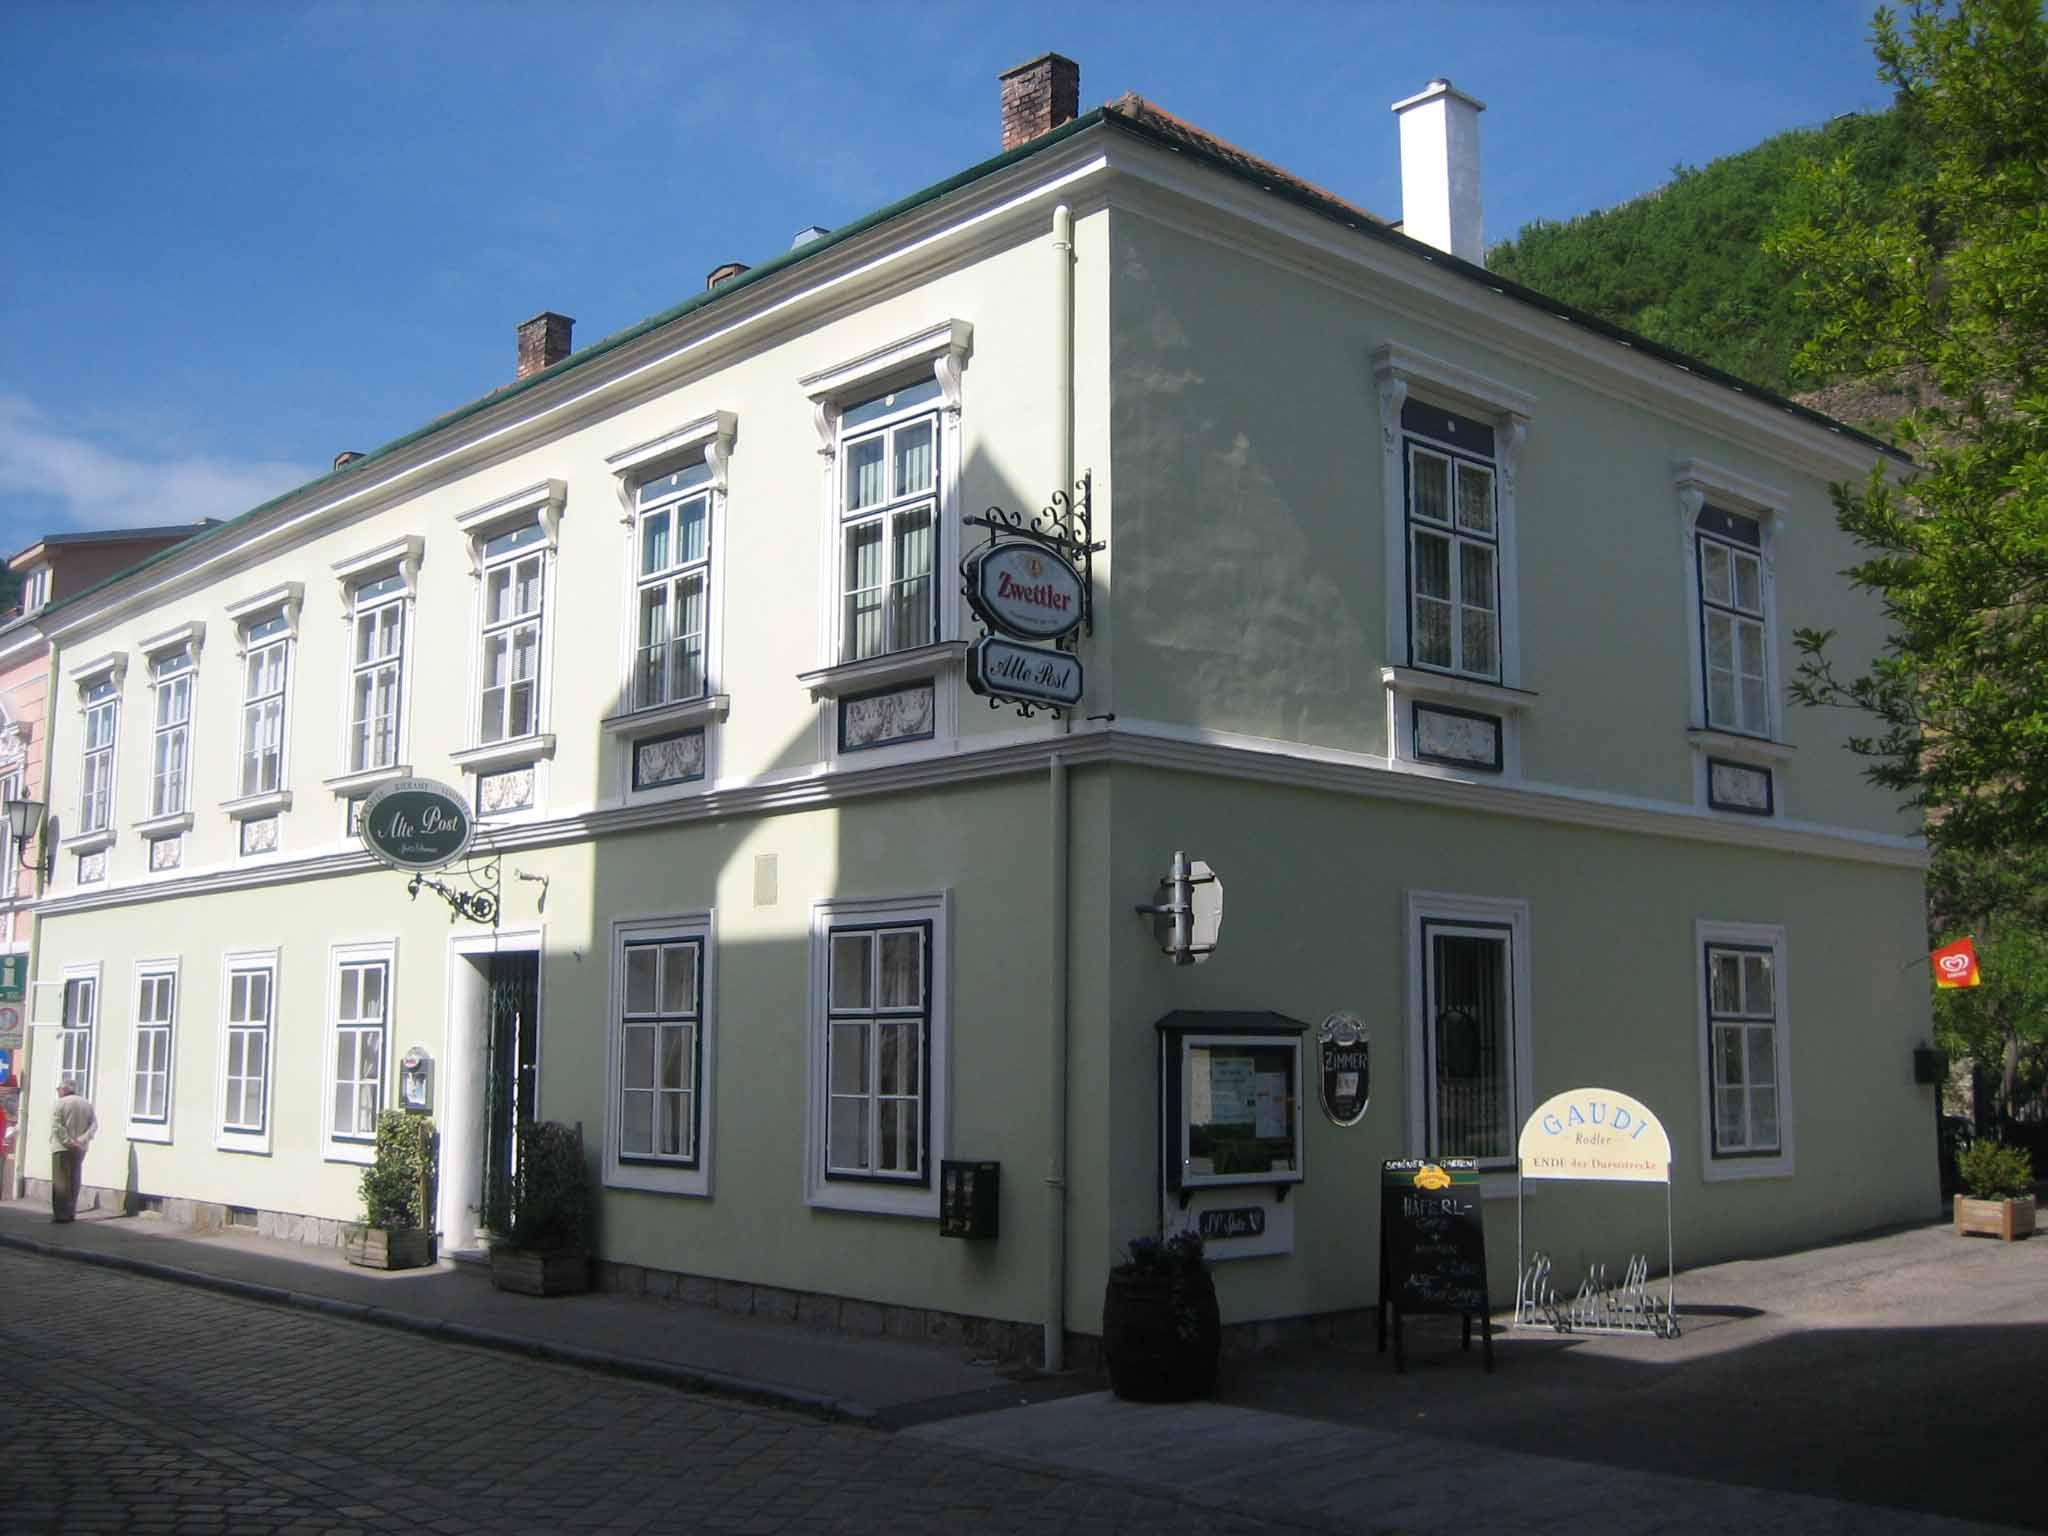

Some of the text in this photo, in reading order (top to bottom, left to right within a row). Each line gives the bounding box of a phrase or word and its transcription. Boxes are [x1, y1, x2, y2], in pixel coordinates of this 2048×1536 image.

[998, 571, 1071, 611] Zwettler
[990, 655, 1071, 689] Alte Post
[378, 806, 458, 838] Alte Post
[1325, 1051, 1368, 1071] ZIMMER
[1542, 1102, 1648, 1140] GAUDI
